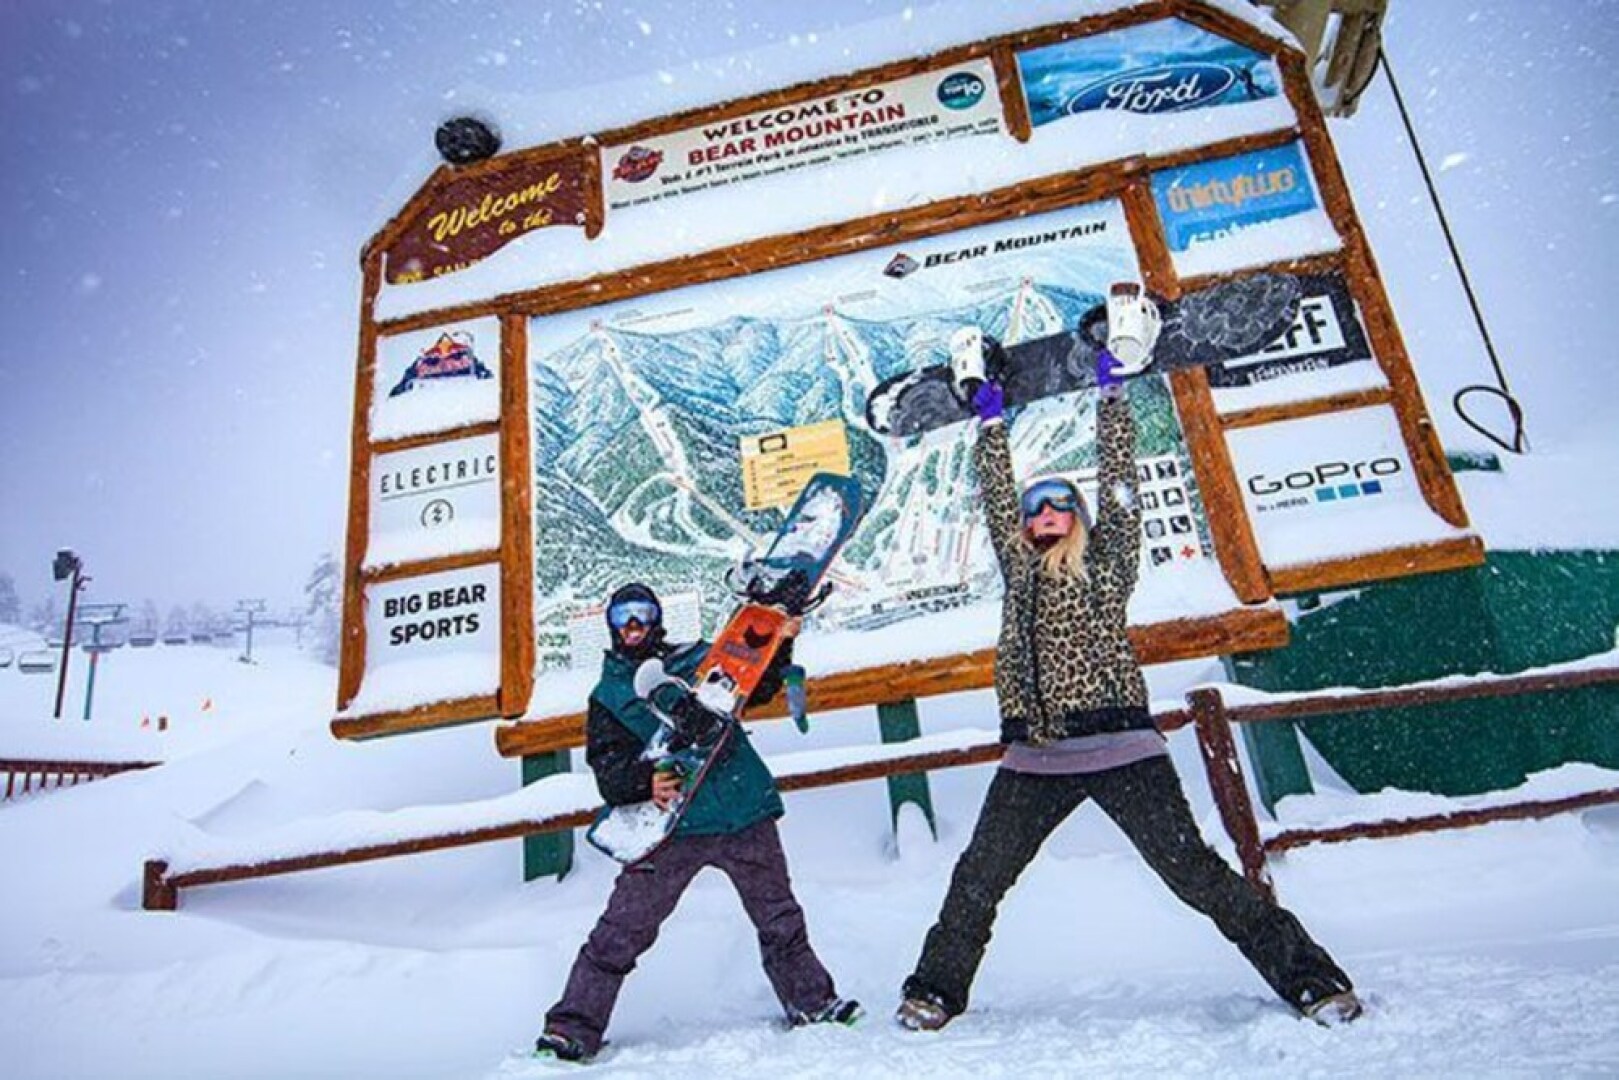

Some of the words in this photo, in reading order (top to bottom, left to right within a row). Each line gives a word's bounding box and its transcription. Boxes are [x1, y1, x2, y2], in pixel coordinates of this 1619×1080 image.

[1101, 69, 1203, 113] Ford
[688, 137, 757, 165] BEAR
[765, 103, 906, 149] MOUNTAIN
[703, 98, 838, 141] WELCOME
[843, 87, 885, 109] TO
[427, 172, 562, 242] Welcome
[1168, 167, 1297, 214] thirtytwo
[498, 221, 518, 237] to
[923, 245, 989, 268] BEAR
[993, 220, 1107, 254] MOUNTAIN
[381, 455, 497, 493] ELECTRIC
[1248, 456, 1402, 496] GoPro
[384, 593, 423, 619] BIG
[428, 583, 487, 611] BEAR
[389, 613, 480, 647] SPORTS
